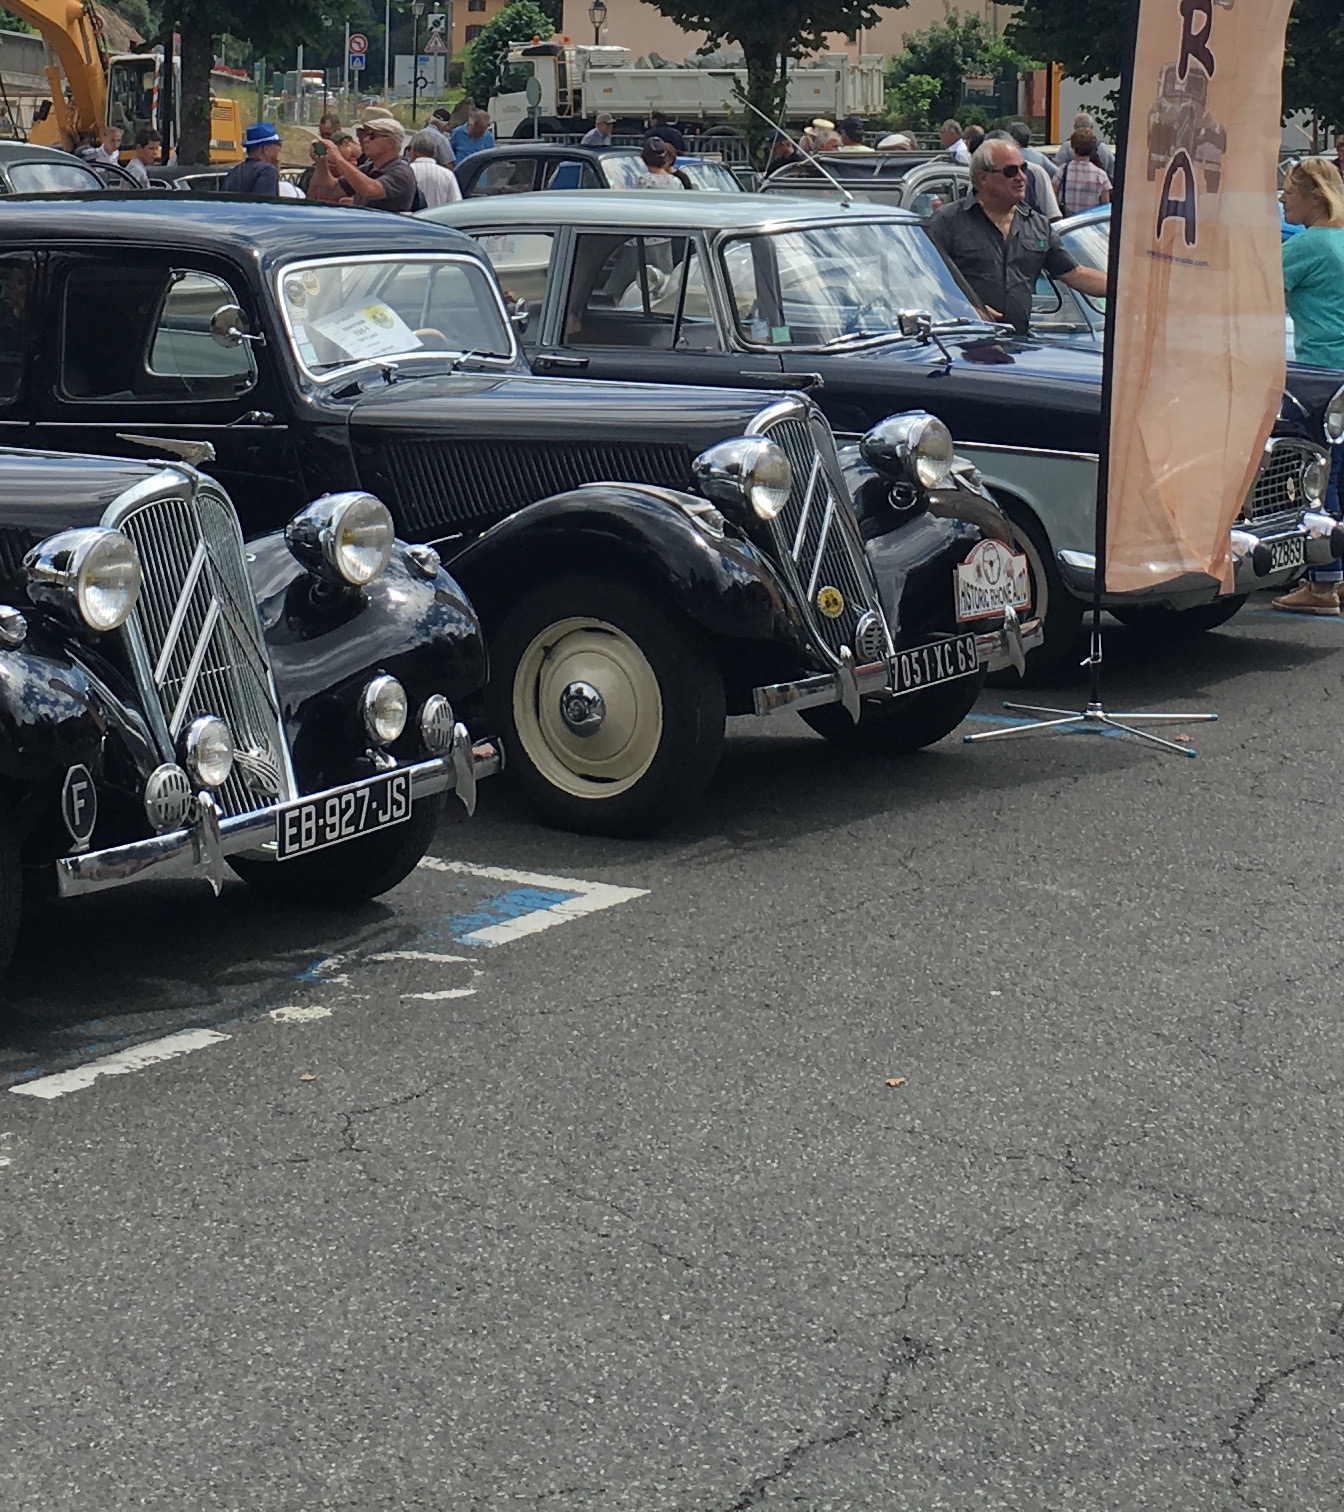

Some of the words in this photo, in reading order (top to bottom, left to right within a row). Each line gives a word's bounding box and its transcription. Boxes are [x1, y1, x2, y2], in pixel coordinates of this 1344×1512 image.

[890, 649, 931, 691] 7051
[933, 643, 954, 679] XC
[956, 637, 976, 672] 69
[71, 781, 88, 826] F
